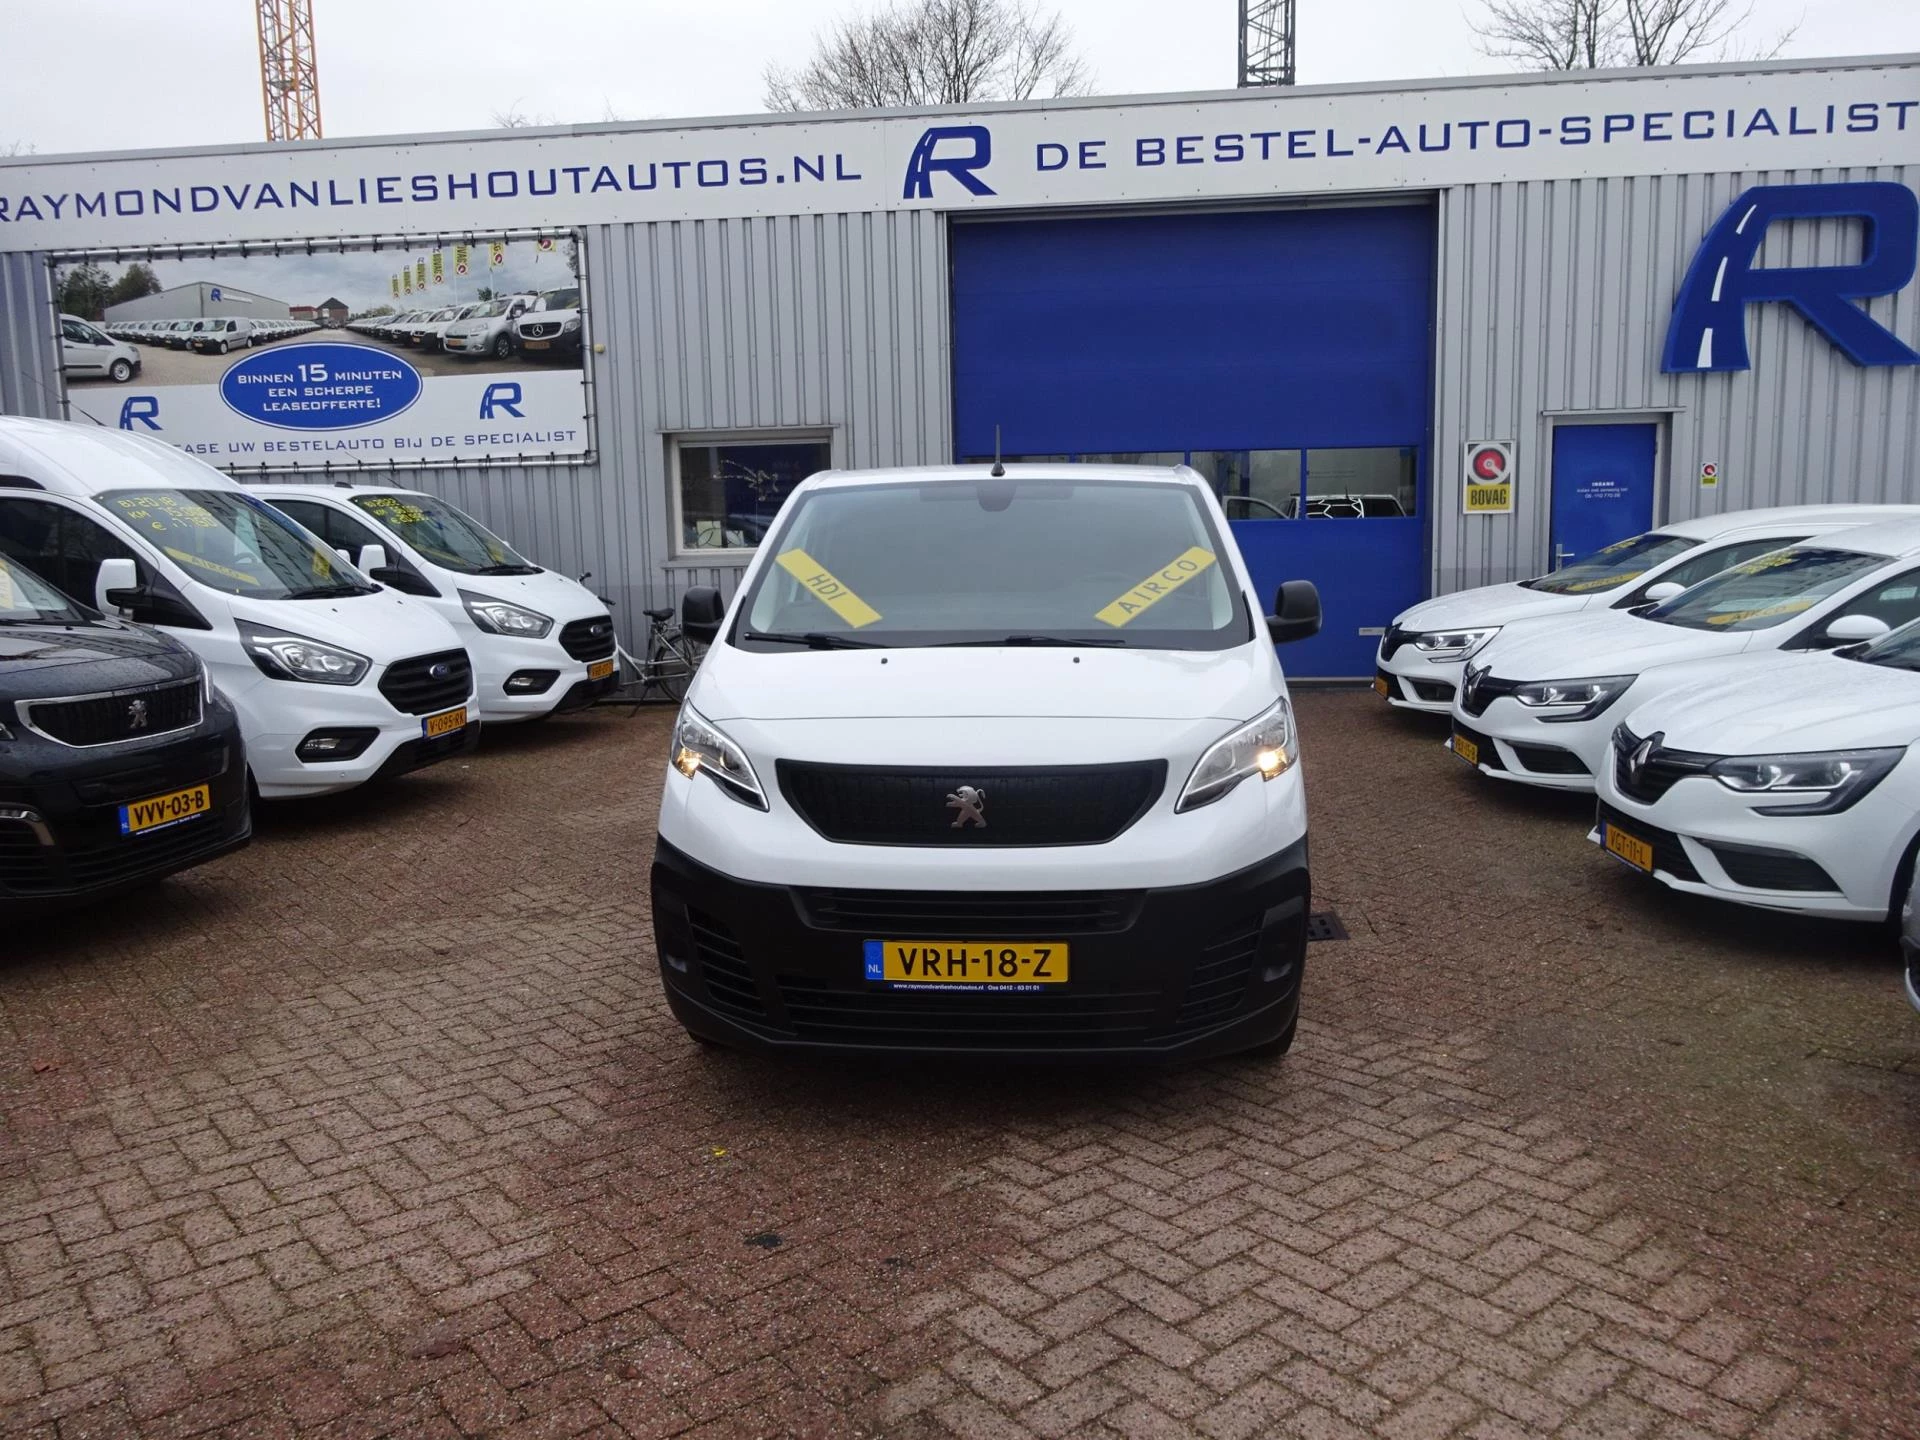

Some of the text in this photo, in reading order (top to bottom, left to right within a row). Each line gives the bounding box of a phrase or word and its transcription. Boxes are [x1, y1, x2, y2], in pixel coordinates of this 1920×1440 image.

[1036, 101, 1920, 171] DE BESTEL-AUTO-SPECIALIST
[237, 364, 402, 384] BINNEN 15 MINUTEN
[263, 398, 381, 411] LEASEOFFERTE!
[268, 385, 374, 397] EEN SCHERPE
[479, 382, 526, 420] R
[119, 396, 163, 431] R
[172, 430, 577, 455] ASE UW BESTELAUTO BIJ DE SPECIALIST
[1470, 489, 1507, 506] BOVAG
[806, 573, 847, 601] HDI
[1117, 559, 1198, 614] AIRCO
[133, 790, 205, 826] VVV-03-B
[868, 947, 1052, 977] NL VRH-18-Z
